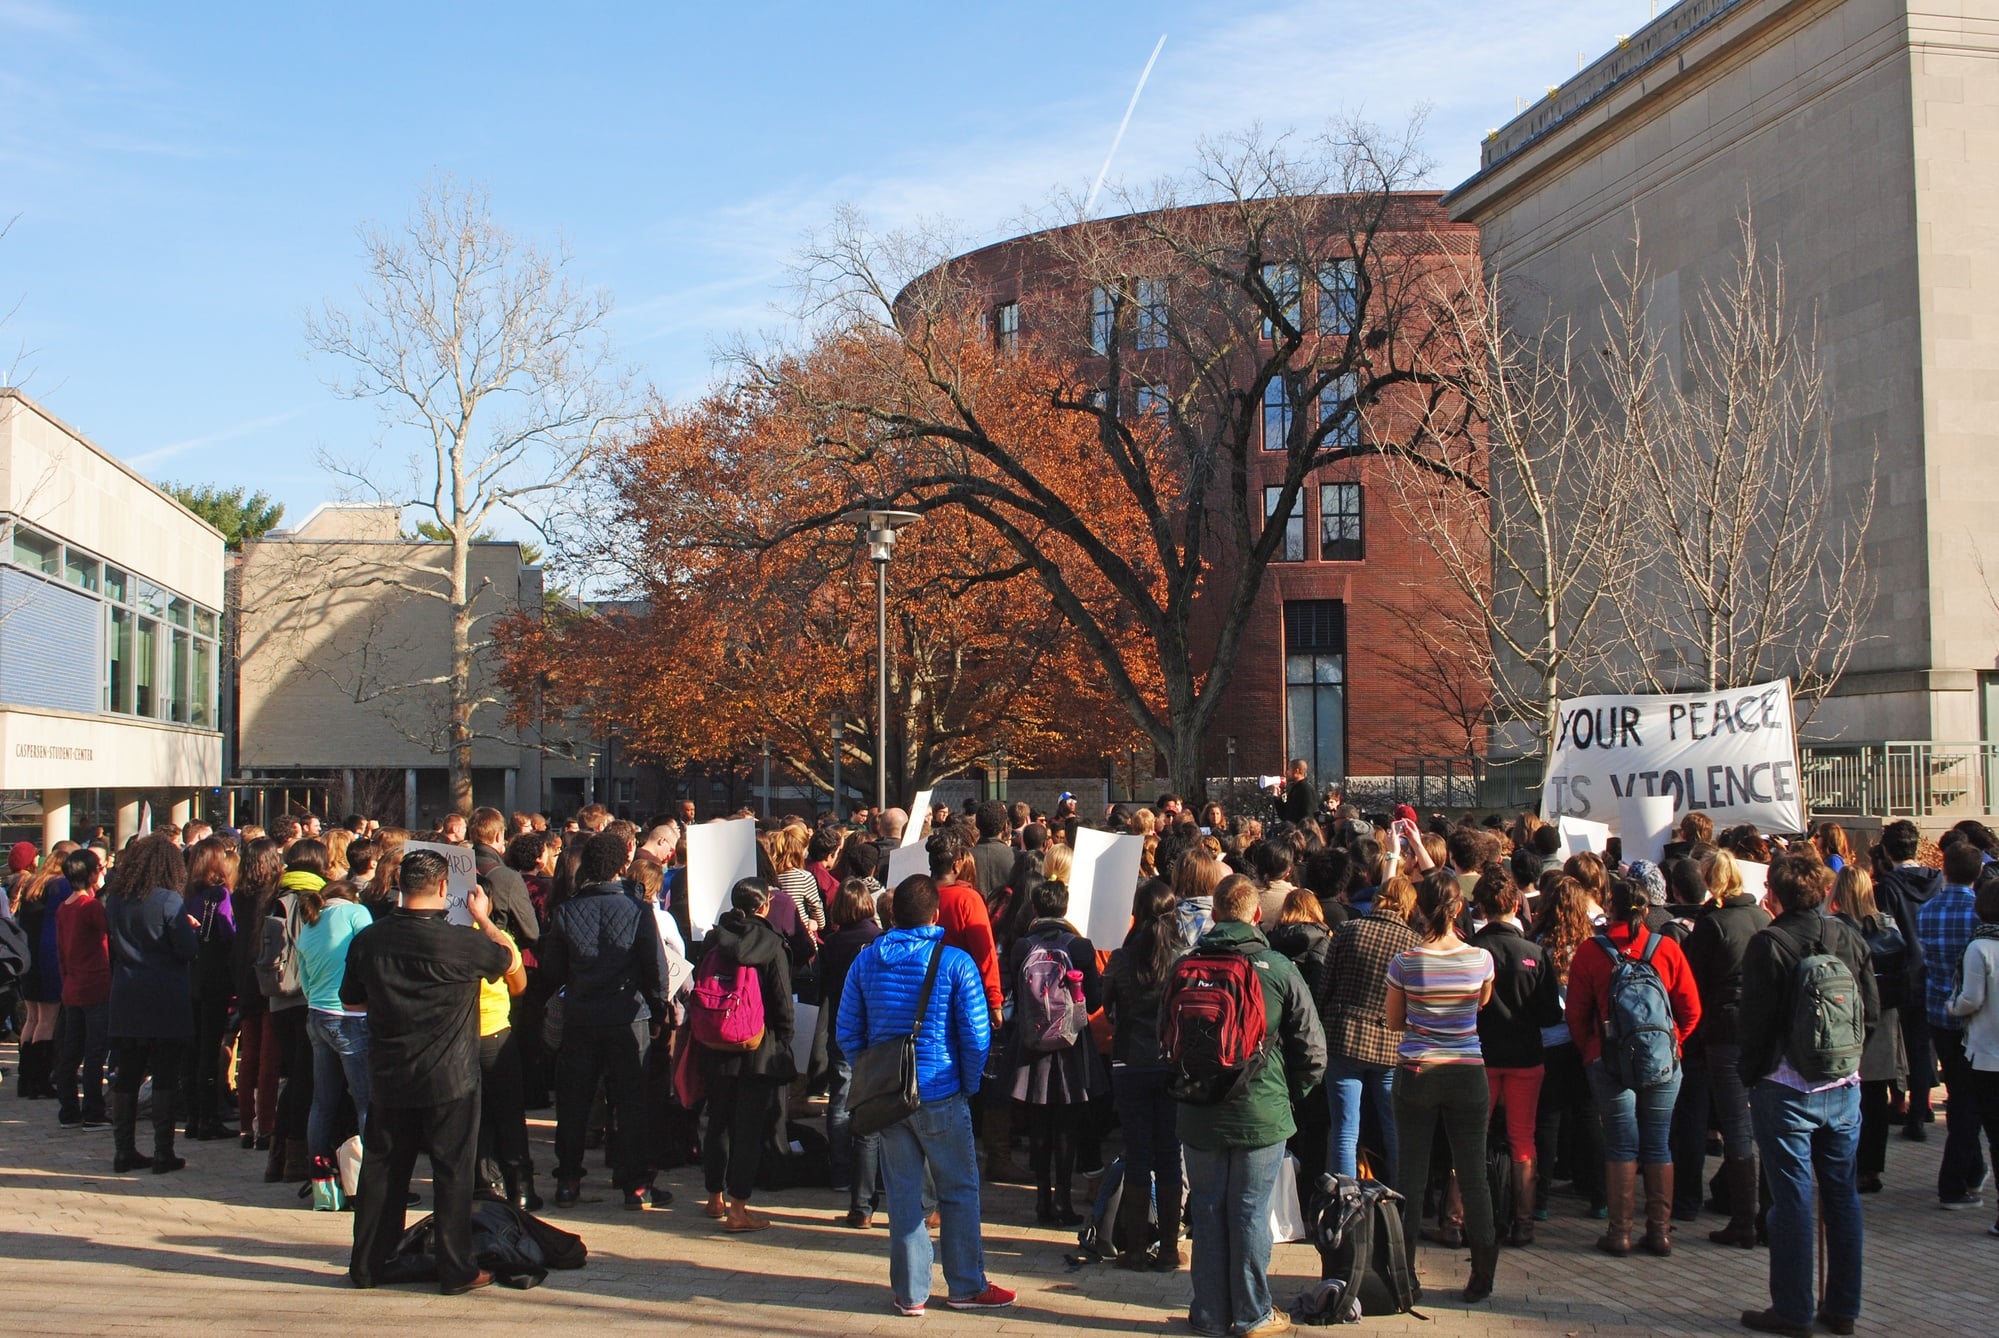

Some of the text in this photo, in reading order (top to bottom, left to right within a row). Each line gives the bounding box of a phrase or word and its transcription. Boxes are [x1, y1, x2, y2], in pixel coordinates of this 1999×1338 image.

[1556, 687, 1783, 751] YOUR PEACE
[1550, 774, 1592, 819] IS
